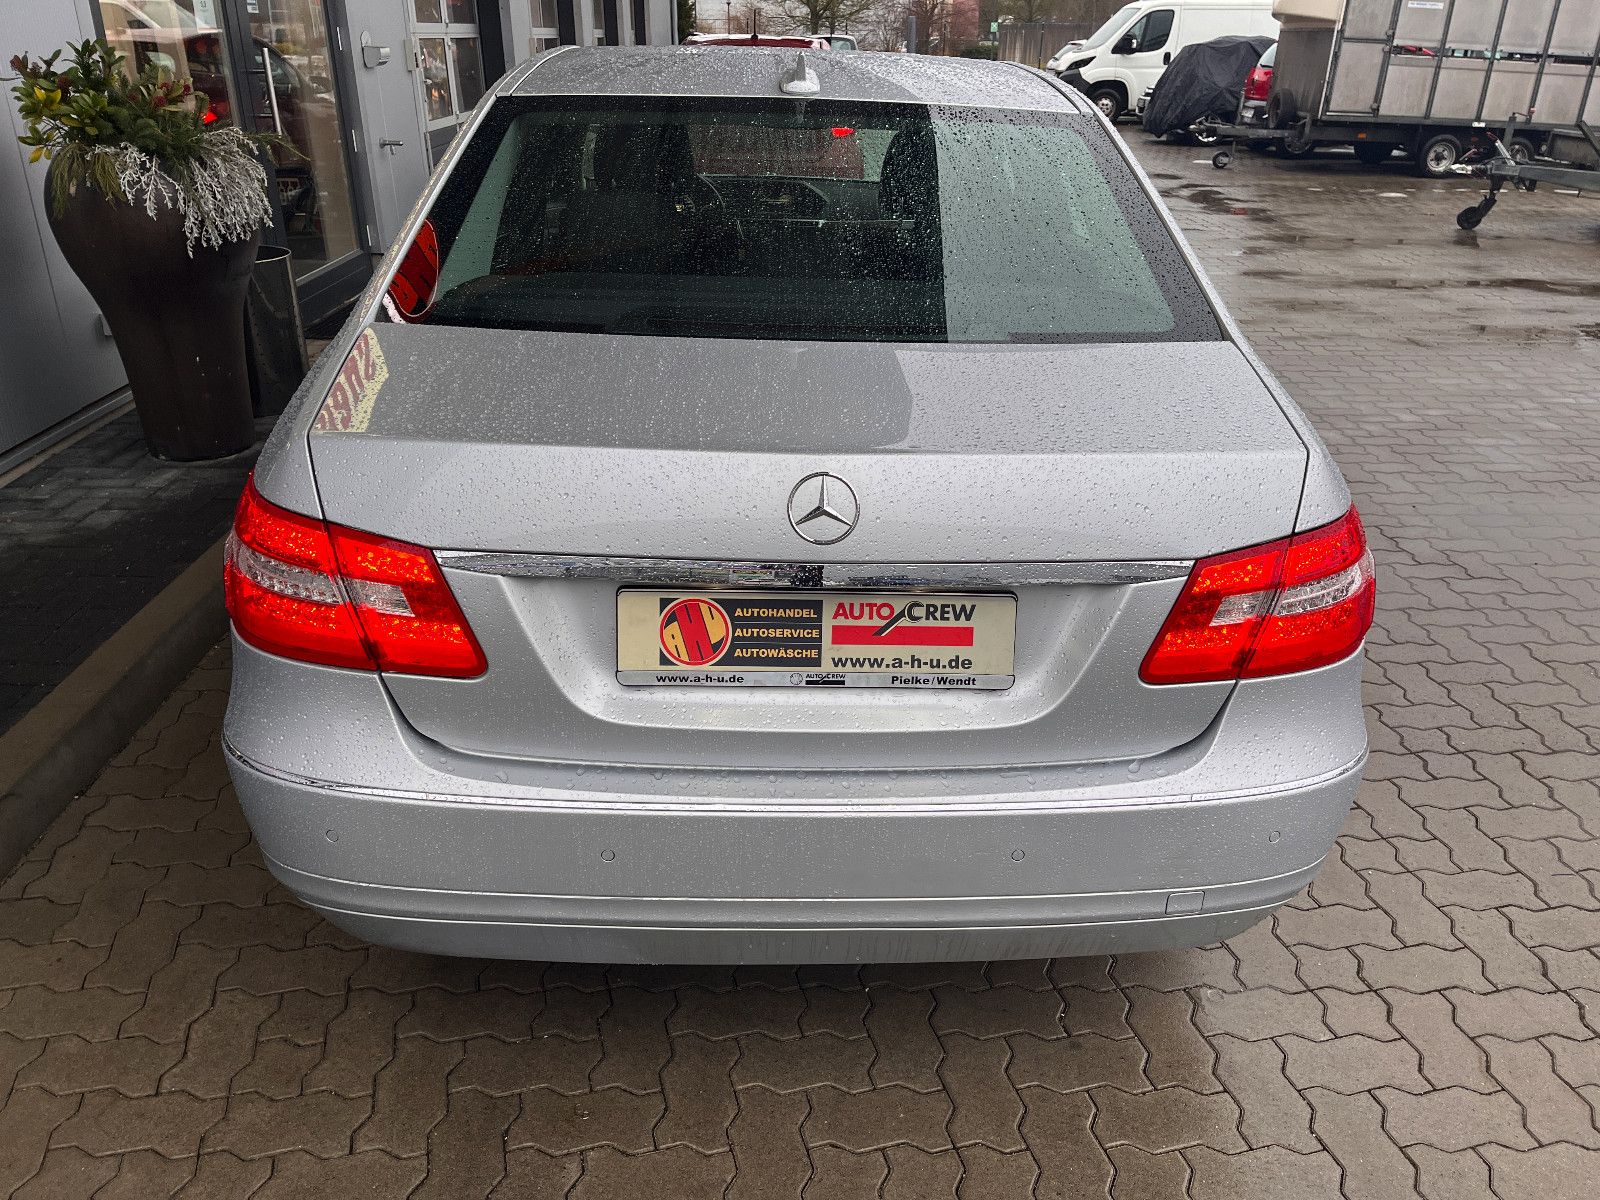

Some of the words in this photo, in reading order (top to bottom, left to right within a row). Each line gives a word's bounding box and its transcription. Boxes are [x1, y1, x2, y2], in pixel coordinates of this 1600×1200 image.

[734, 608, 818, 618] AUTOHANDEL
[832, 602, 895, 621] AUTO
[906, 601, 977, 622] CREW
[734, 628, 820, 639] AUTOSERVICE
[734, 647, 819, 659] AUTOWÄSCHE
[831, 655, 973, 670] www.a-h-u.de
[656, 674, 745, 685] www.a-h-u.de
[891, 676, 977, 687] Pielke/Wendt
